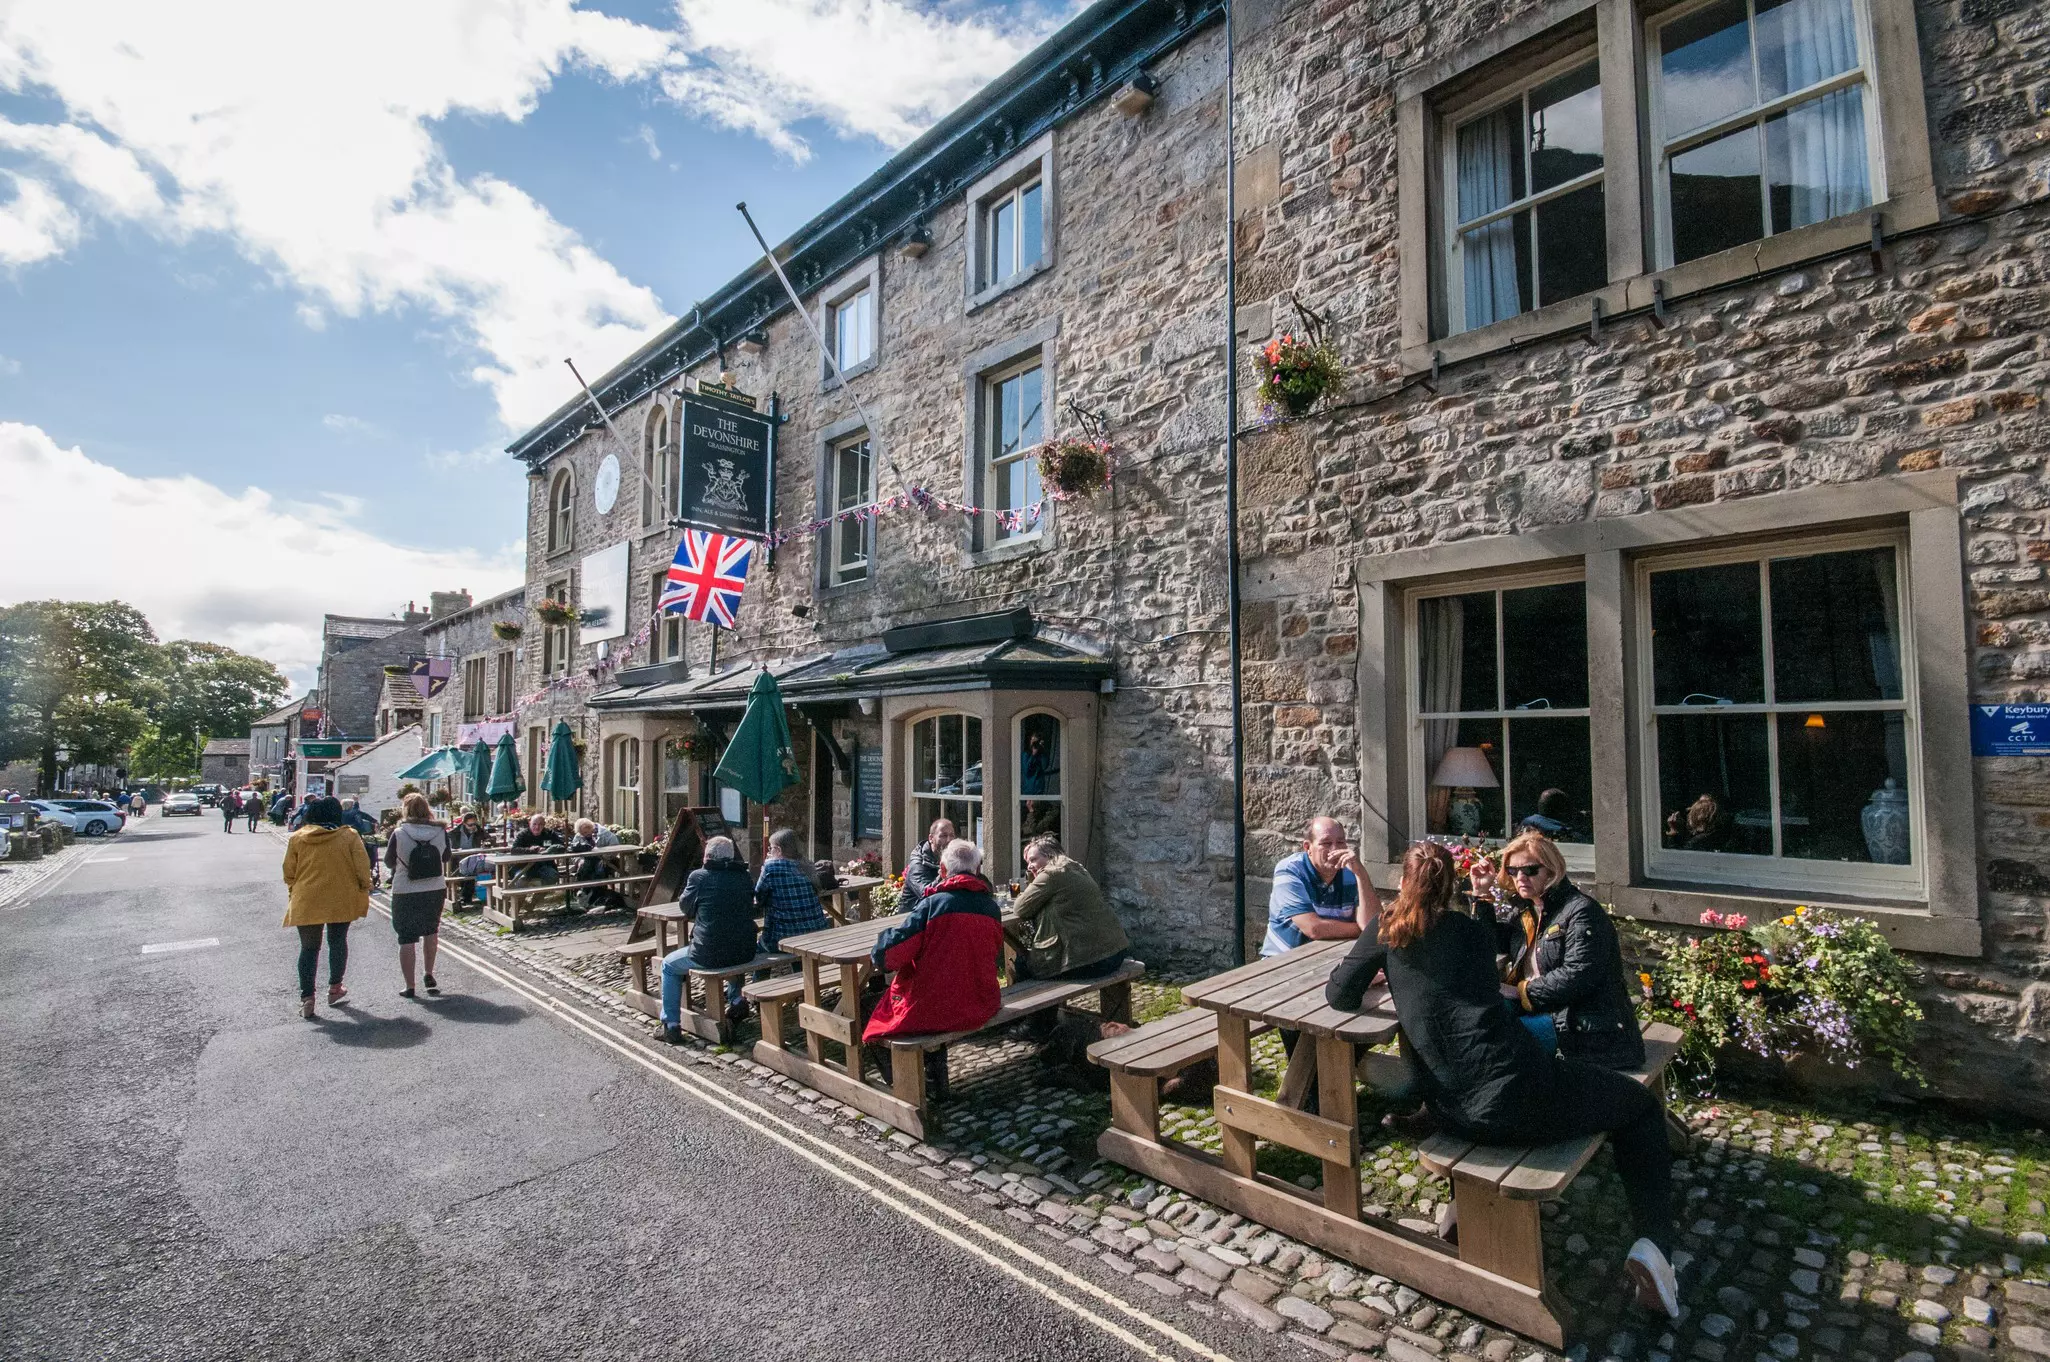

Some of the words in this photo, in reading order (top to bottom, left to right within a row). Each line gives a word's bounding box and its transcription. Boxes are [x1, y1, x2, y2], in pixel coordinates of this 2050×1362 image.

[700, 384, 727, 396] TIMOTHY
[729, 393, 755, 405] TAYLOR'S
[717, 417, 738, 433] THE
[693, 424, 759, 451] DEVONSHIRE
[707, 441, 746, 456] GRASSINGTON
[720, 511, 739, 520] DINING
[740, 516, 757, 524] HOUSE
[2005, 706, 2050, 715] Keybury
